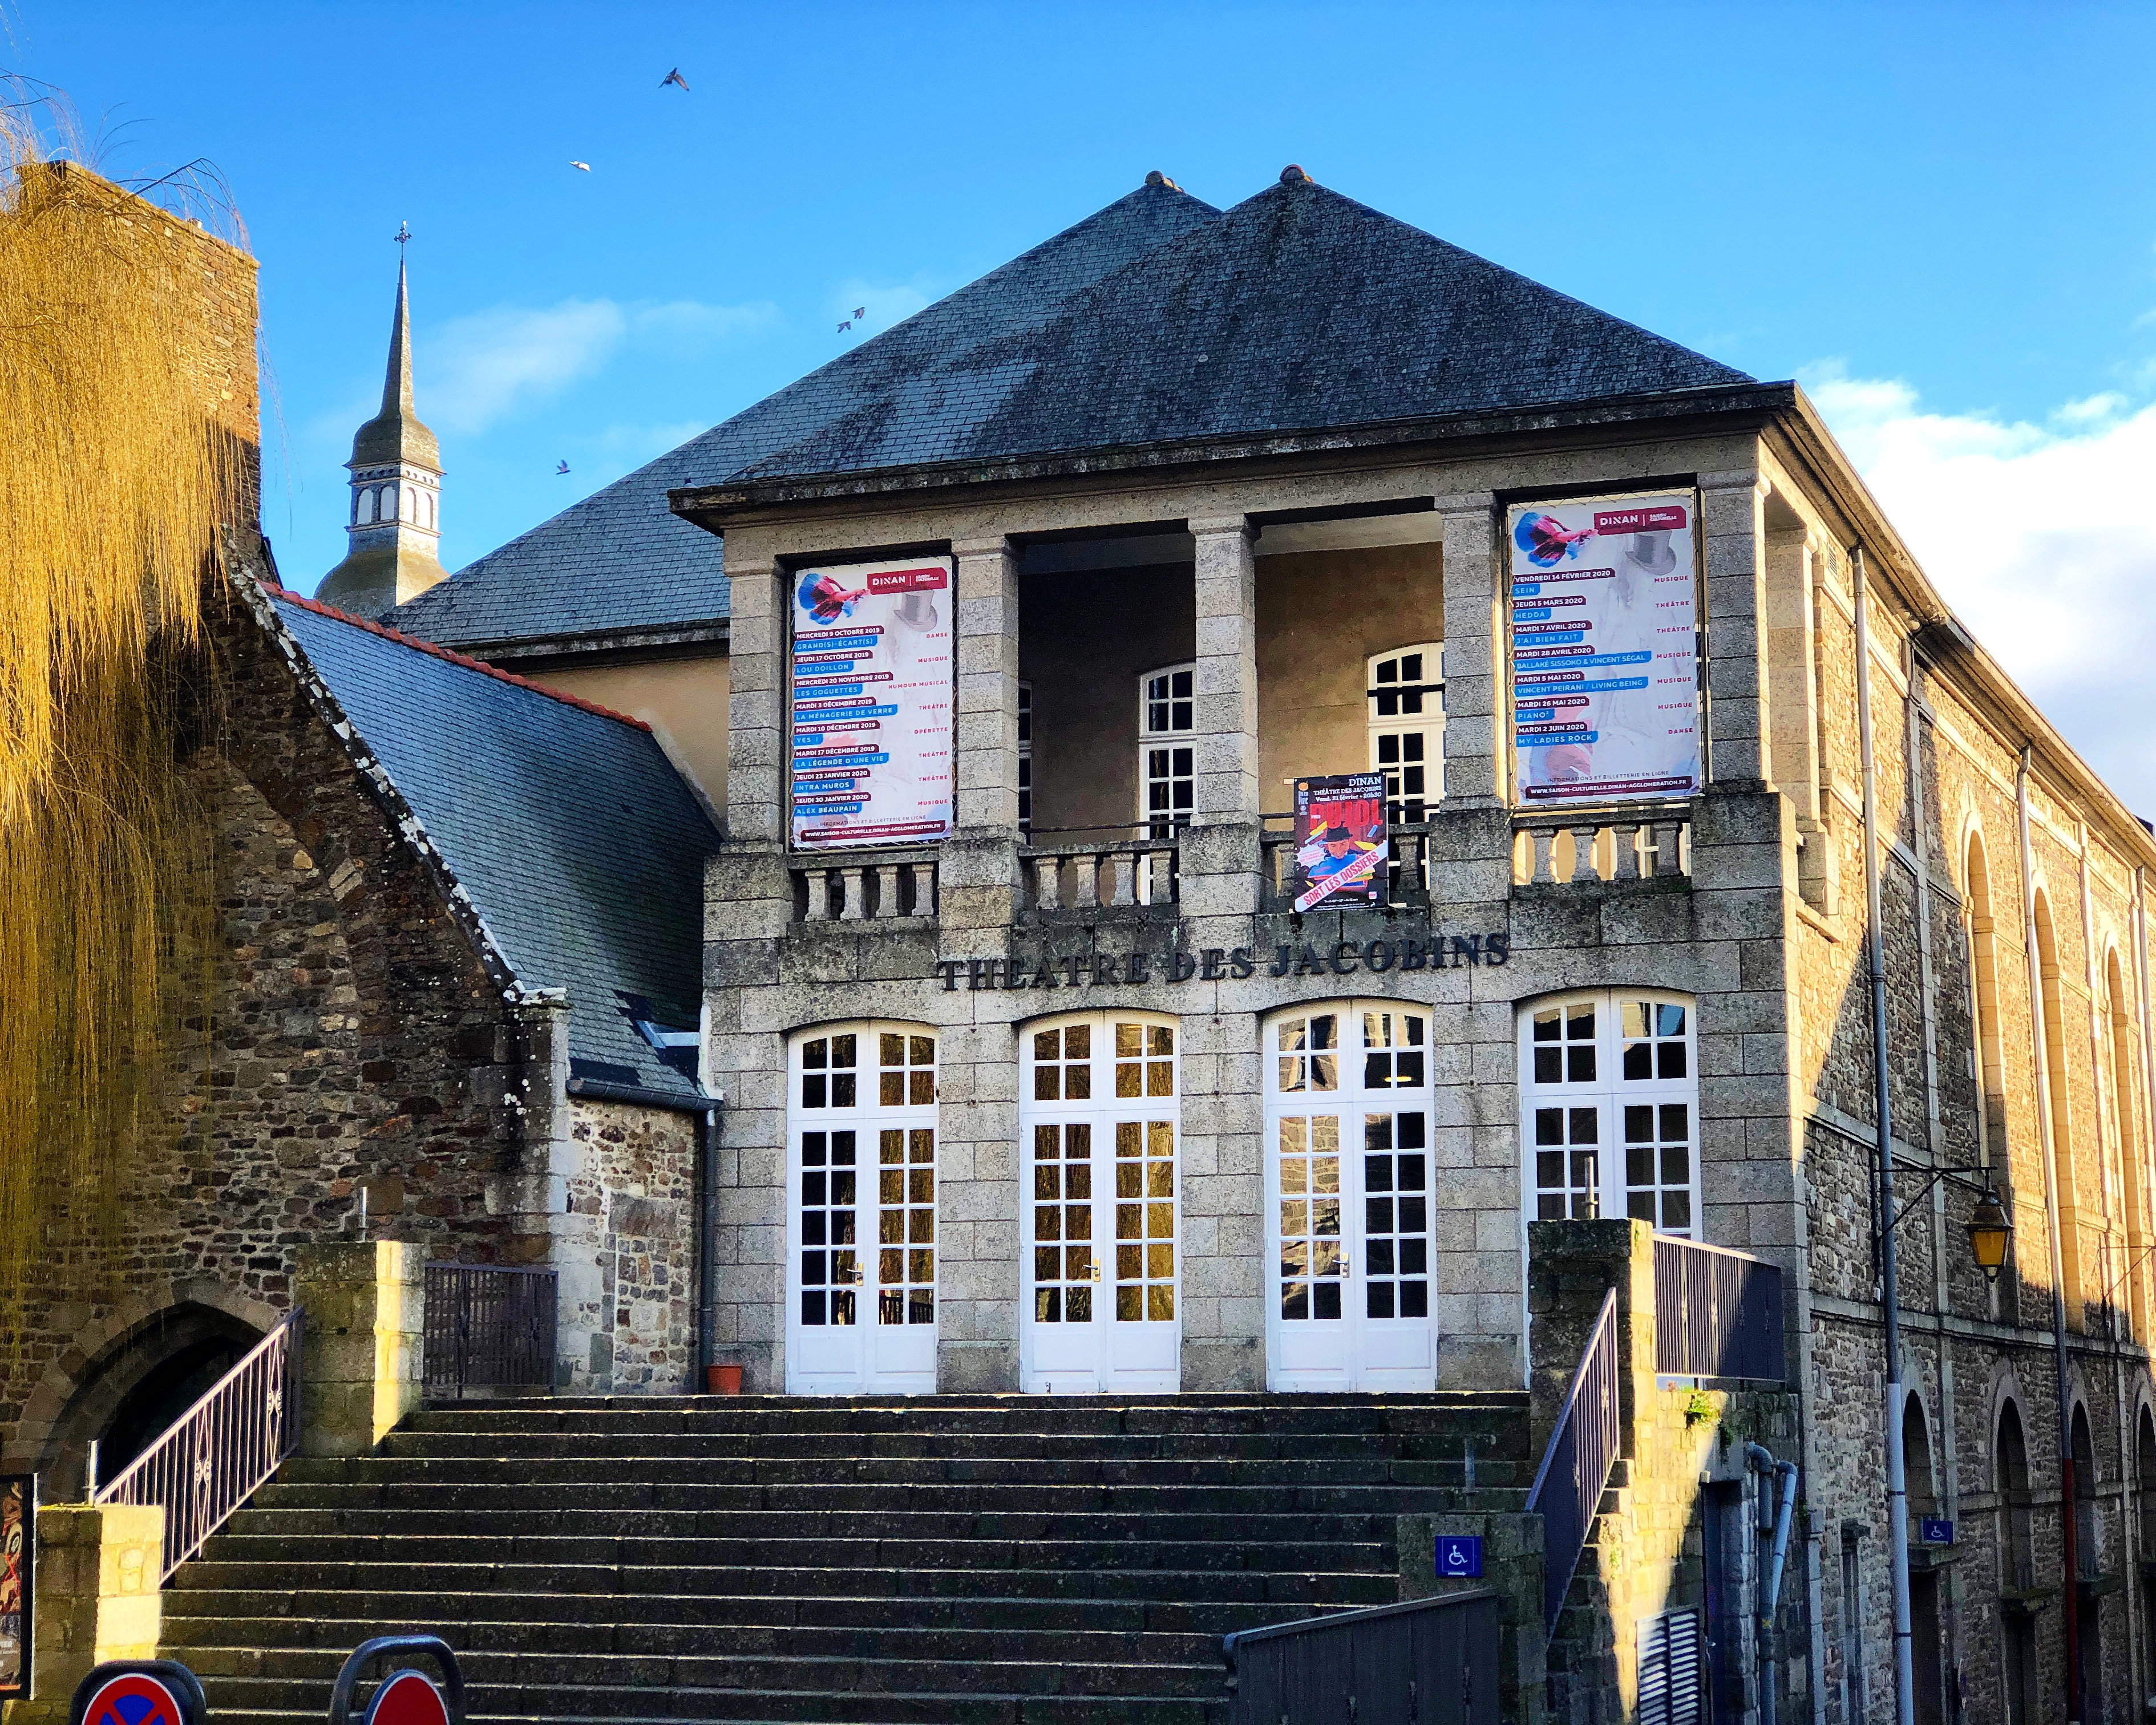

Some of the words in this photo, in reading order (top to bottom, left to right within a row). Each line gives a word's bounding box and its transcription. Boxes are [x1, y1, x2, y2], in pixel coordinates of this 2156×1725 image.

[1600, 515, 1638, 526] DINAN
[872, 576, 905, 585] DINAN
[1622, 653, 1645, 662] SÉGAL
[812, 687, 857, 695] GOGUETTES
[1349, 776, 1381, 786] DINAN
[1310, 799, 1383, 829] PUJOL
[1303, 888, 1325, 906] SORT
[1325, 877, 1341, 895] LES
[1341, 851, 1379, 882] DOSSIERS
[939, 950, 1149, 990] THEATRE
[1166, 946, 1253, 983] DES
[1270, 930, 1508, 976] JACOBINS
